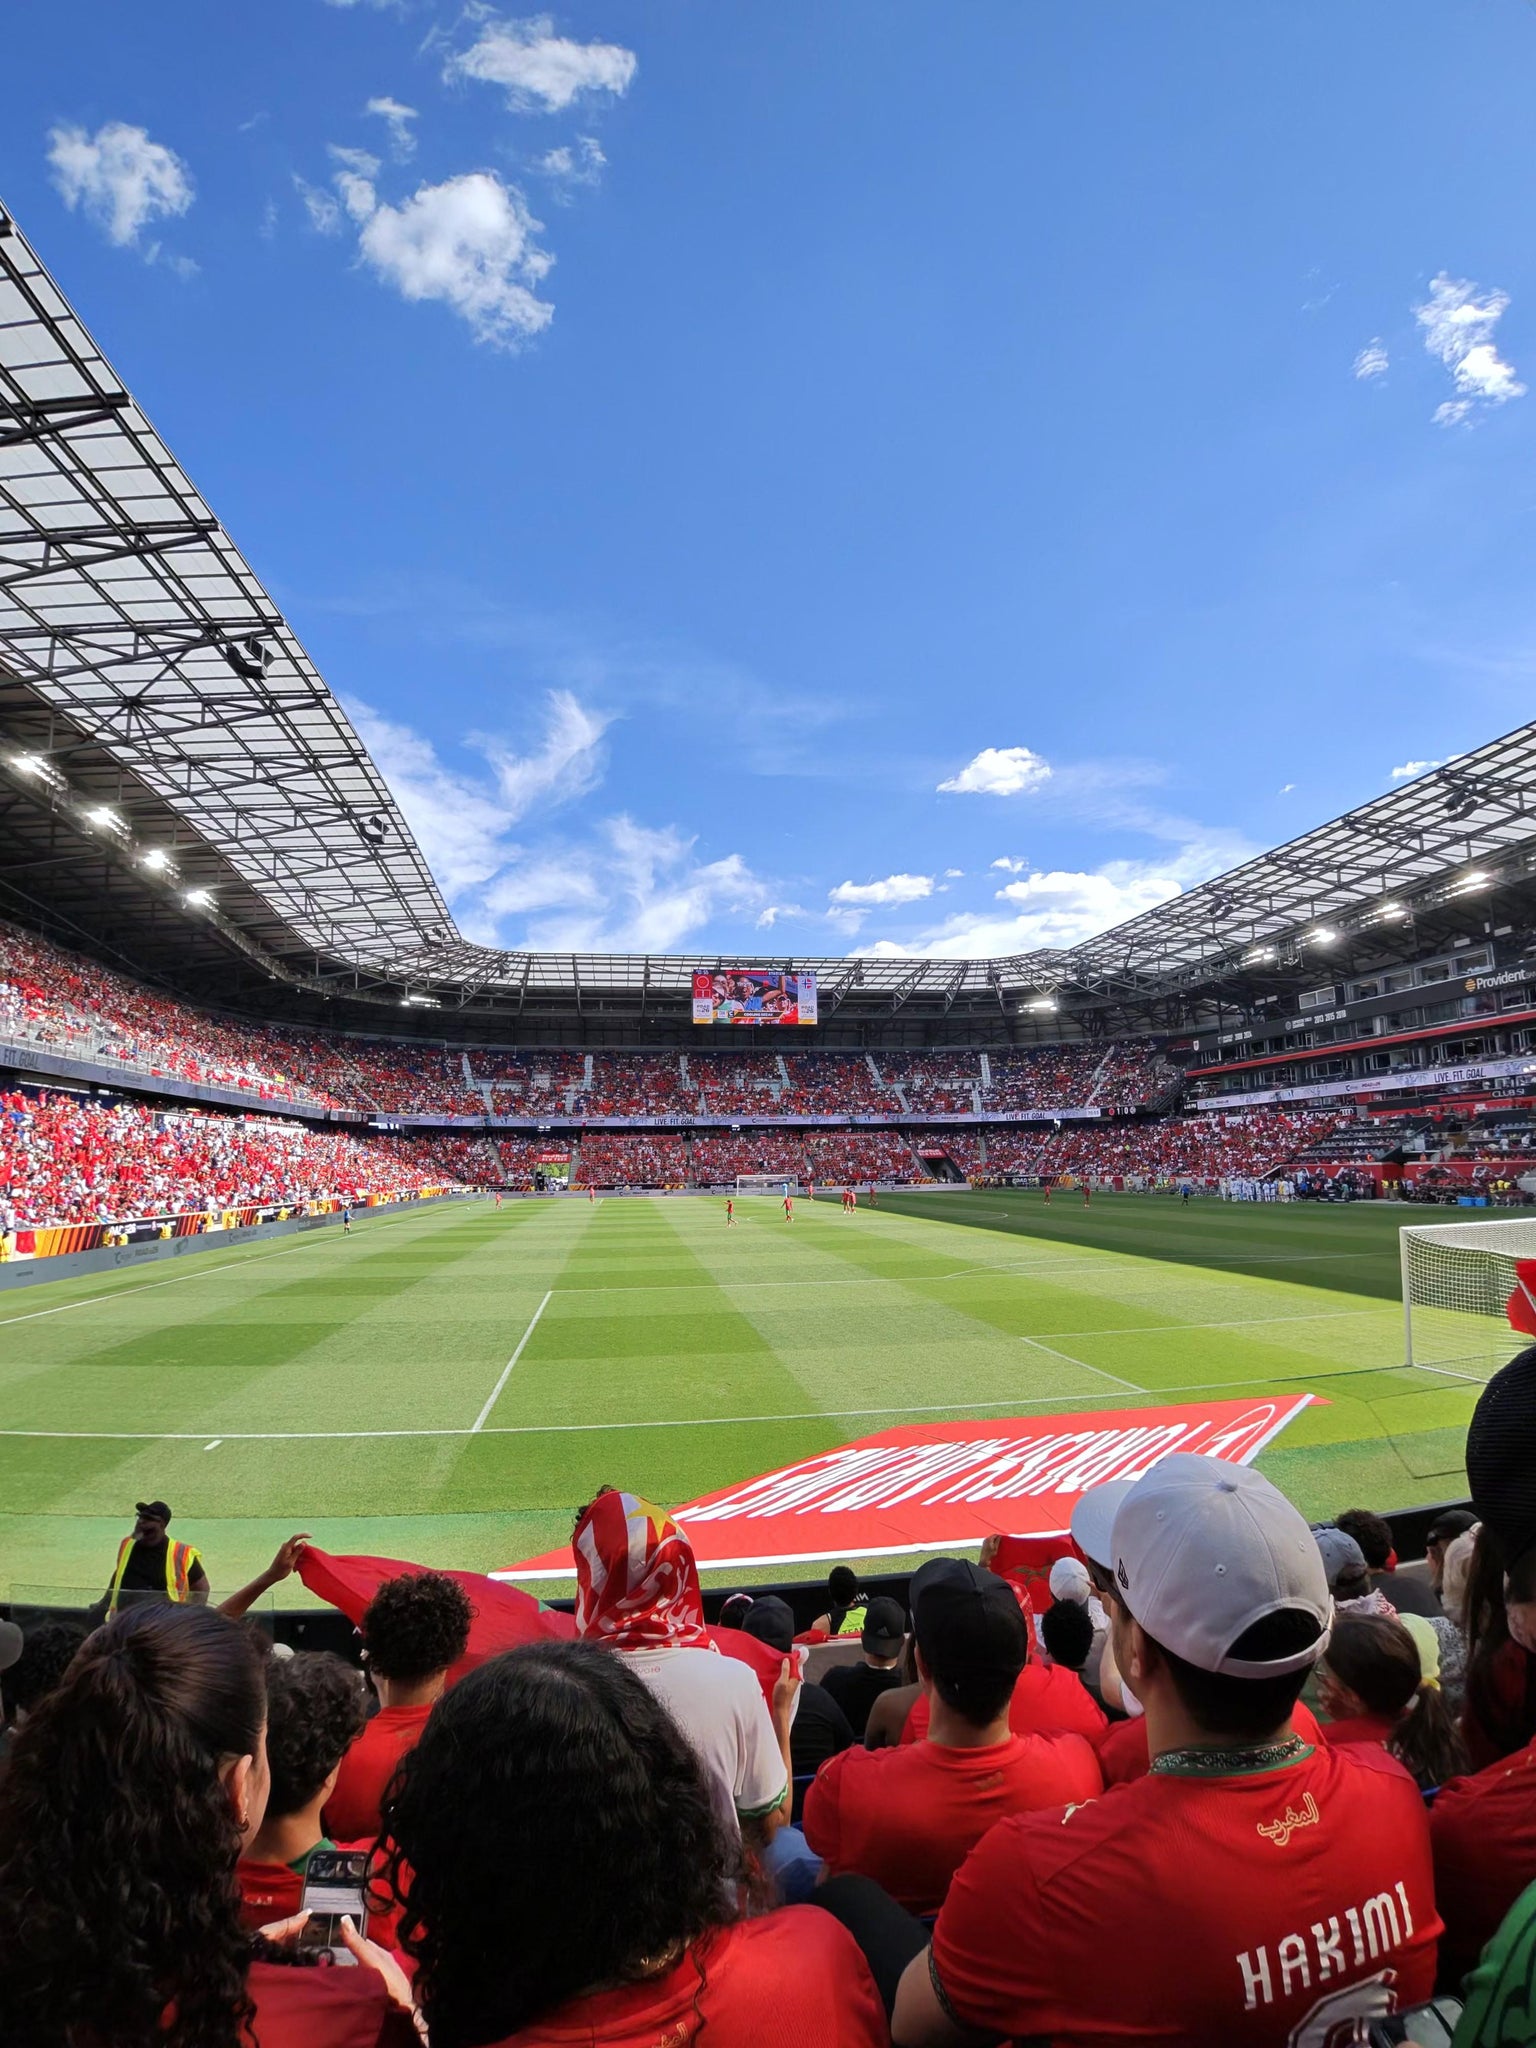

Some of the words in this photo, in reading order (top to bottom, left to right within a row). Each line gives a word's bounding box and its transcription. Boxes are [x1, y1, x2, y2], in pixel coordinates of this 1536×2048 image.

[1476, 969, 1526, 990] Provident
[1313, 1014, 1324, 1024] 2013
[1324, 1012, 1335, 1022] 2015
[1492, 1088, 1515, 1098] CLUB
[671, 1439, 1020, 1523] AIRLINES
[920, 1420, 1213, 1507] TURKISH
[1256, 1792, 1320, 1847] المغرب
[1236, 1881, 1415, 2012] HAKIMI
